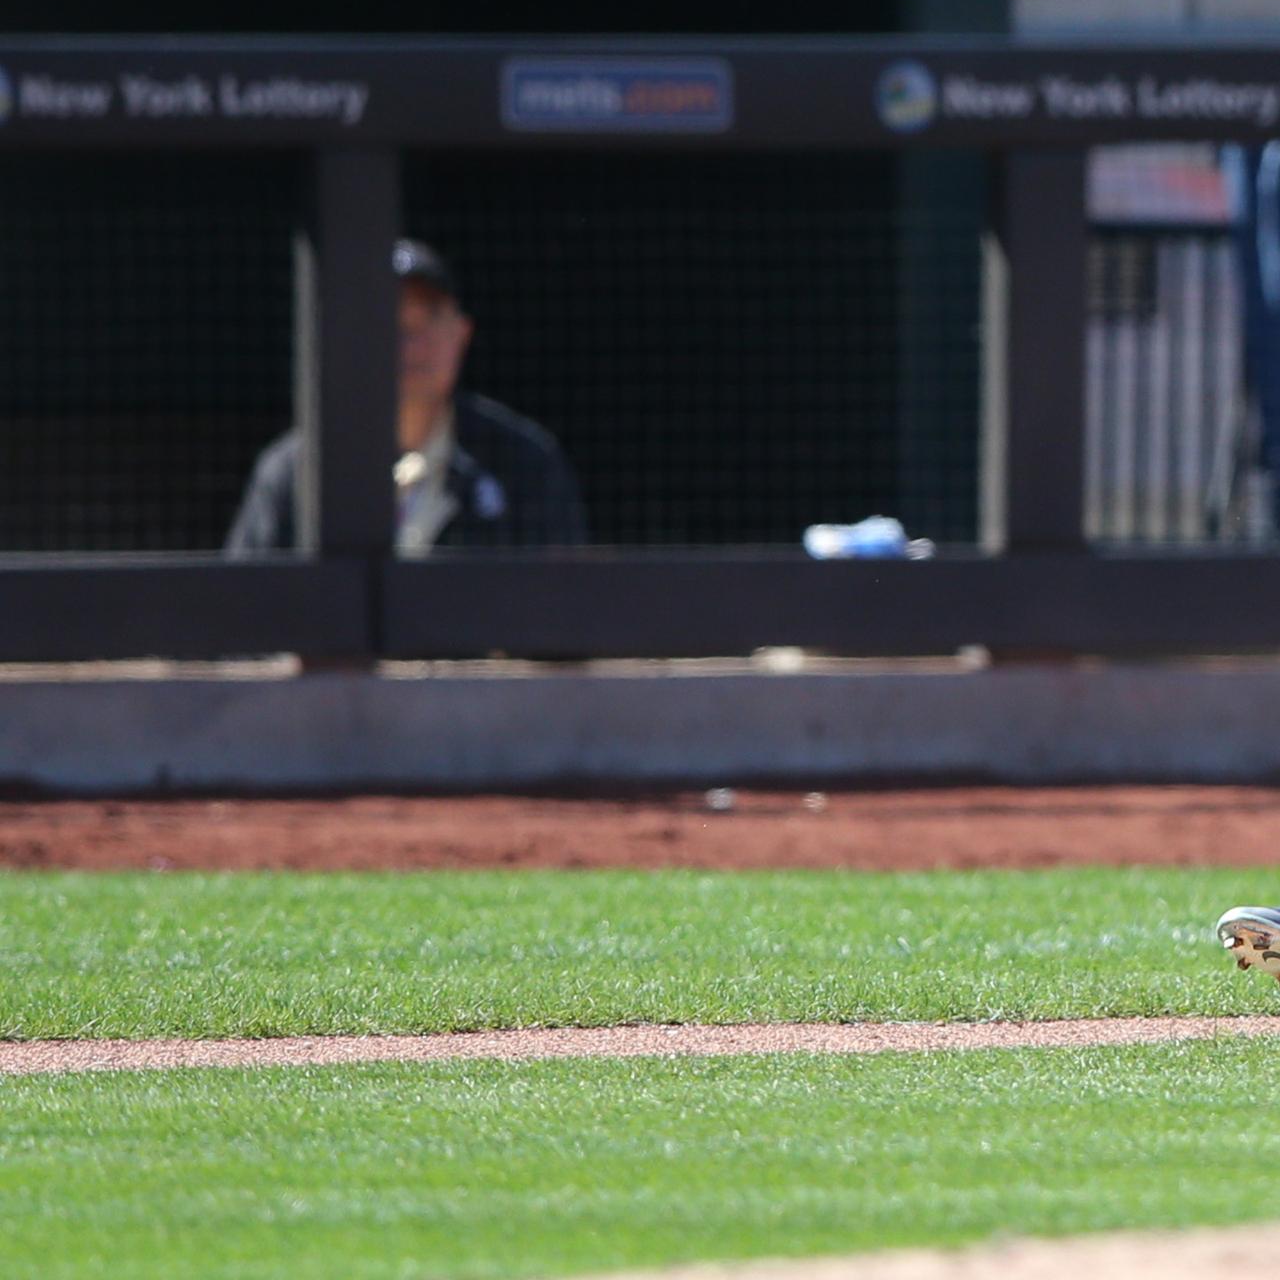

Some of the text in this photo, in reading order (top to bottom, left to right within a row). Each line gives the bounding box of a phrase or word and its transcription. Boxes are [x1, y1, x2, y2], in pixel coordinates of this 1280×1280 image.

[20, 73, 369, 123] New York Lottery
[943, 74, 1033, 115] New
[1042, 74, 1130, 115] York
